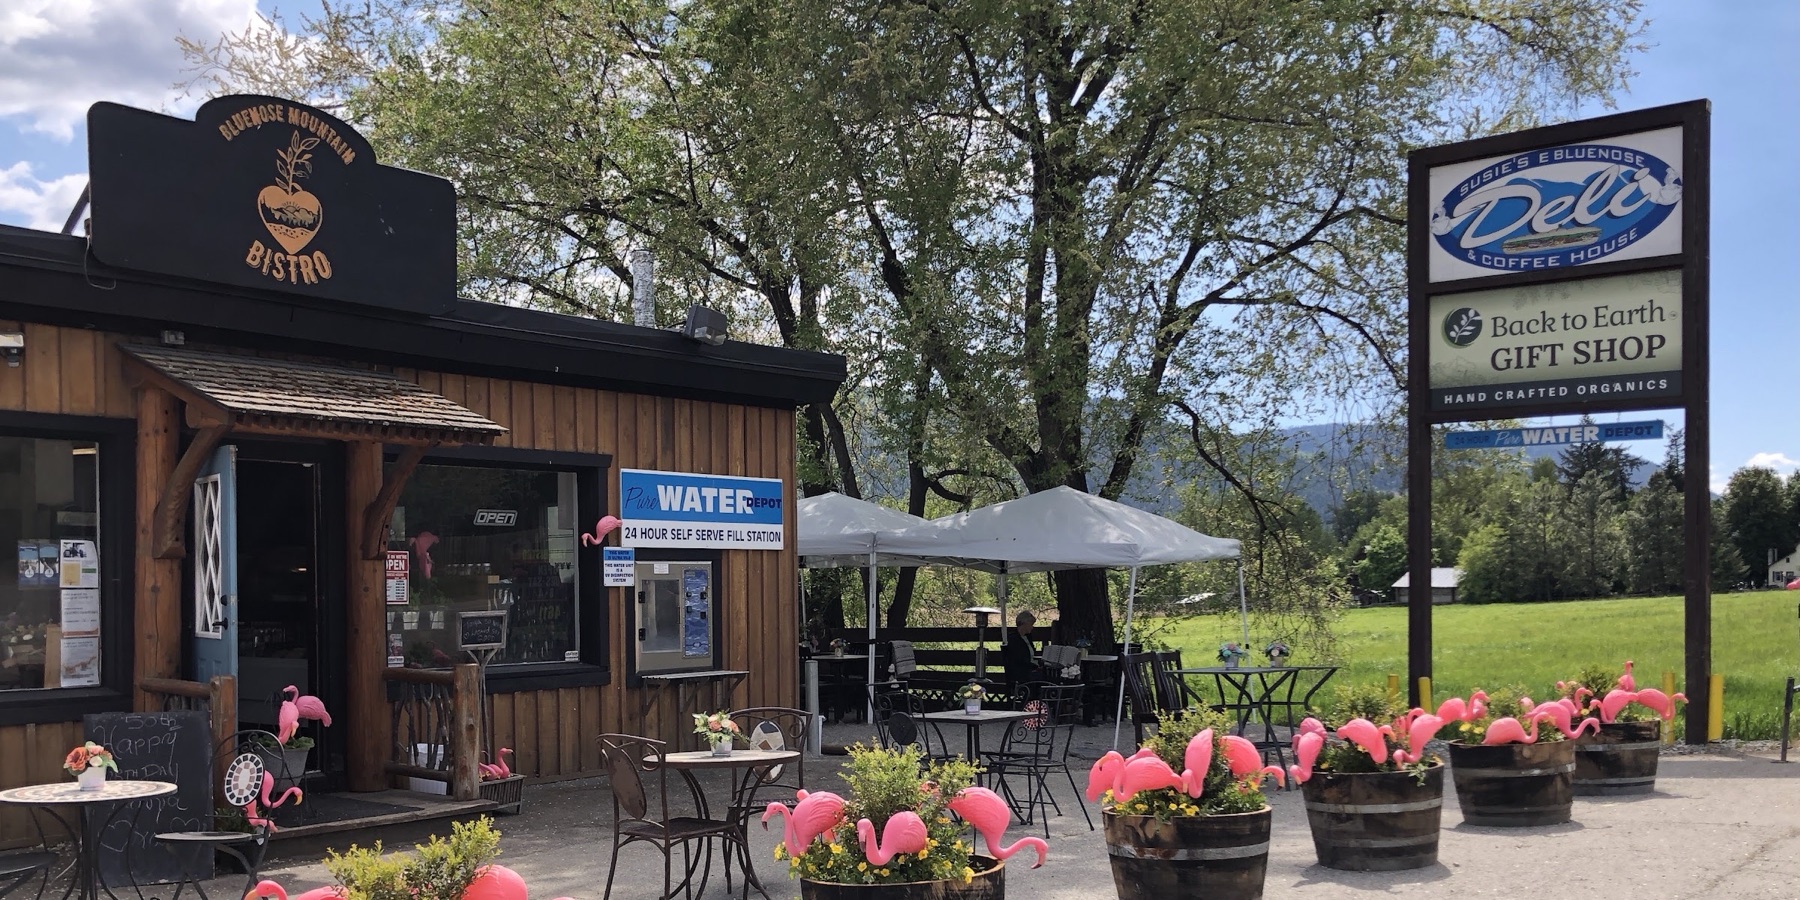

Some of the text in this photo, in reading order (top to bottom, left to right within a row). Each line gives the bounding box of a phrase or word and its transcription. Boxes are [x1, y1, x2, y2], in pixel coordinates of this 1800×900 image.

[218, 104, 356, 166] BLUENOSE MOUNTAIN
[1459, 157, 1529, 197] SUSIE'S
[1554, 148, 1645, 168] BLUENOSE
[1451, 164, 1652, 249] Deli
[245, 240, 333, 285] BISTRO
[1467, 227, 1638, 269] & COFFEE HOUSE
[1490, 299, 1667, 338] Back to Earth
[1490, 334, 1667, 372] GIFT SHOP
[1444, 379, 1669, 405] HAND CRAFTED ORGANICS
[1455, 425, 1654, 447] 24 HOUR Pure WATER DEPOT
[476, 512, 515, 524] OPEN
[624, 484, 783, 515] Pure WATER DEPOT
[624, 526, 782, 543] 24 HOUR SELF SERVE FILL STATION
[93, 725, 177, 776] Happy
